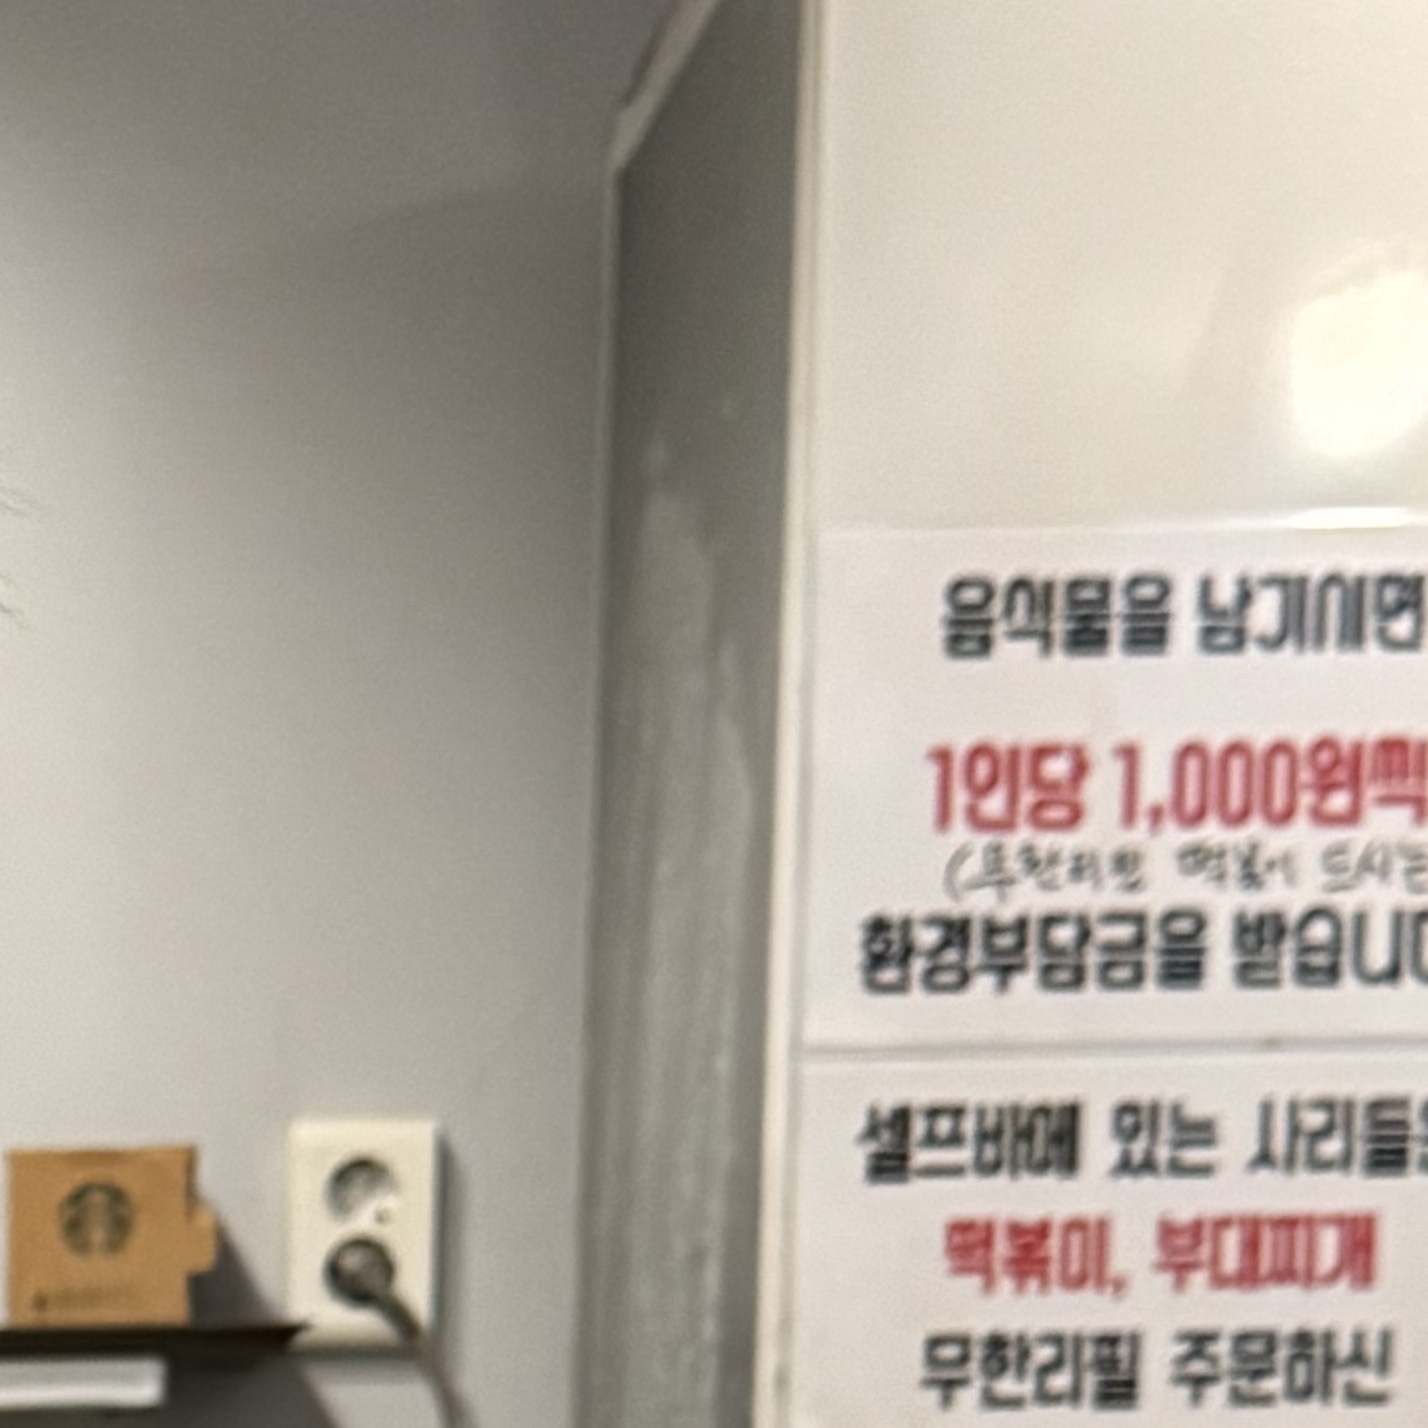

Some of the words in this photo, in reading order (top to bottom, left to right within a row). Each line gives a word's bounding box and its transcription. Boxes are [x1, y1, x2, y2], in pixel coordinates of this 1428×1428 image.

[944, 574, 1172, 660] 음식물을
[1197, 572, 1426, 657] 남기시면
[928, 742, 1089, 832] 1인당
[861, 907, 1208, 994] 환경부담금을
[858, 1100, 1083, 1184] 셀프바에
[1110, 1100, 1218, 1177] 있는
[1248, 1094, 1428, 1178] 사리들
[944, 1216, 1127, 1296] 떡볶이,
[1154, 1211, 1380, 1292] 부대찌개
[921, 1332, 1142, 1410] 무한리필
[1172, 1328, 1395, 1408] 주문하신
